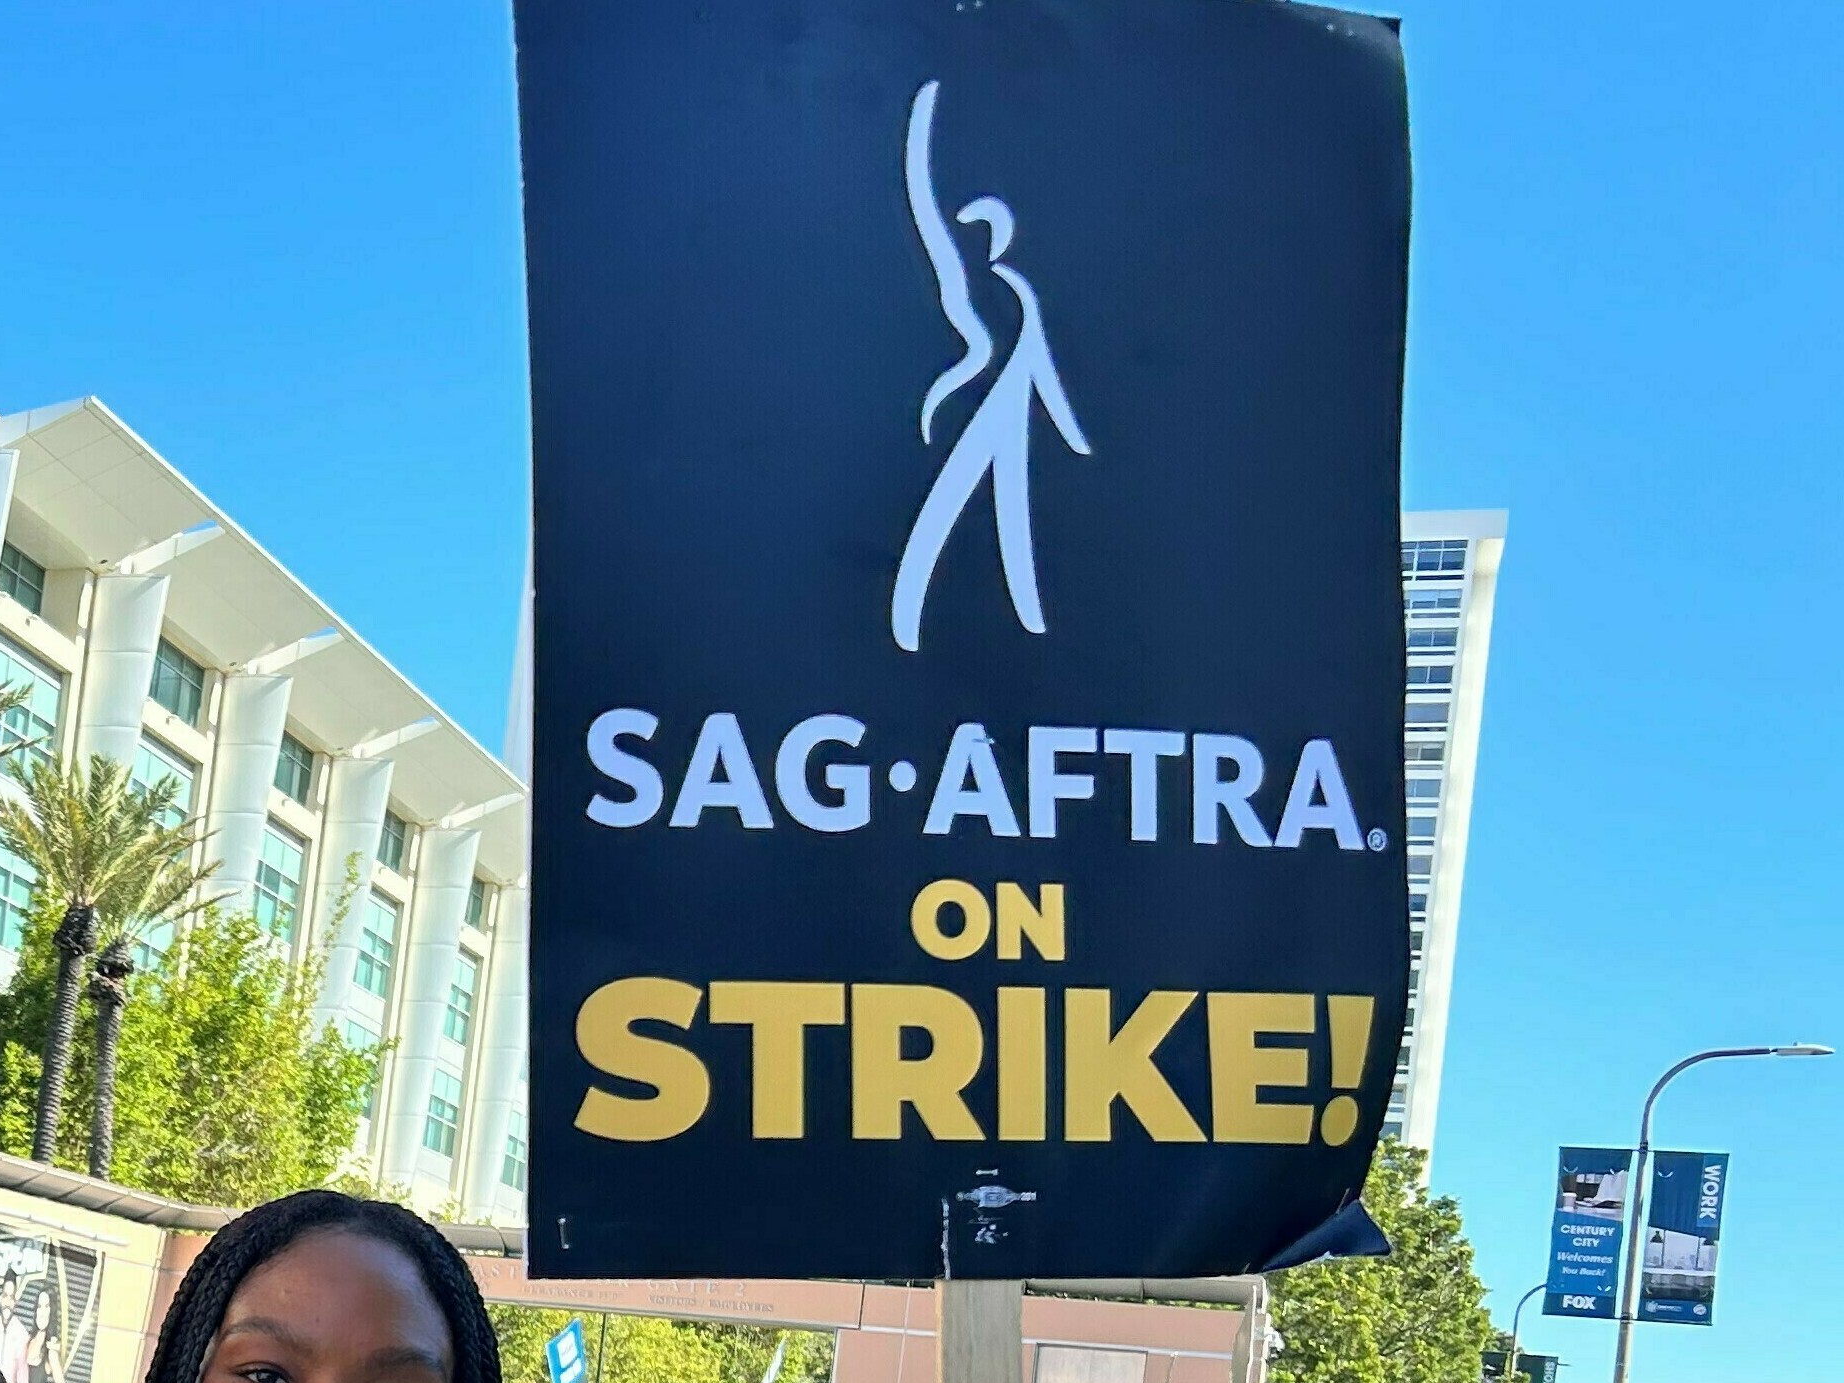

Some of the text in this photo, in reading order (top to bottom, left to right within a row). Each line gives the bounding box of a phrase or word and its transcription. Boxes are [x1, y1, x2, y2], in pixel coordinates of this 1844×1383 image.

[911, 880, 1065, 962] ON
[573, 976, 1375, 1147] STRIKE!
[1699, 1164, 1723, 1219] WORK
[1560, 1224, 1615, 1236] CENTURY
[1572, 1237, 1600, 1248] CITY
[1556, 1251, 1614, 1264] Welcomes
[1562, 1295, 1596, 1310] FOX
